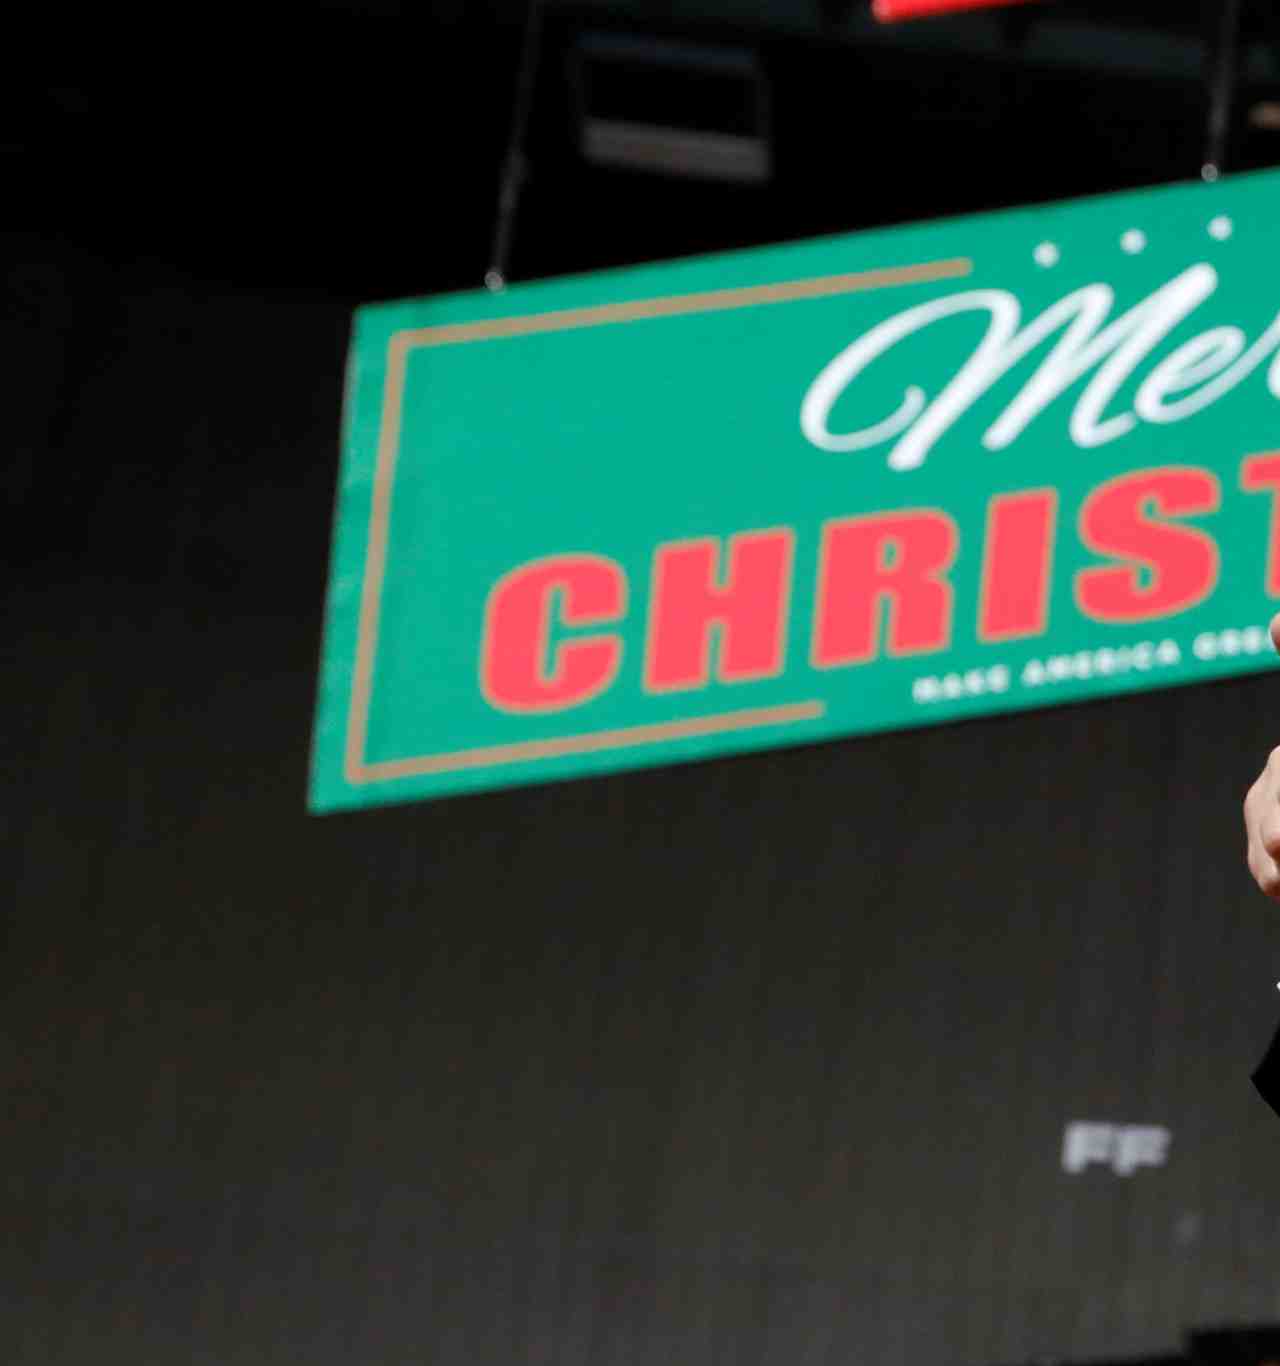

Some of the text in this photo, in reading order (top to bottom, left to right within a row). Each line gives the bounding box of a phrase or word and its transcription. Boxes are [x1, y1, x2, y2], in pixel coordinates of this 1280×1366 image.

[911, 662, 1010, 705] MAKE
[1020, 636, 1182, 688] AMERICA
[1192, 624, 1276, 661] GRE
